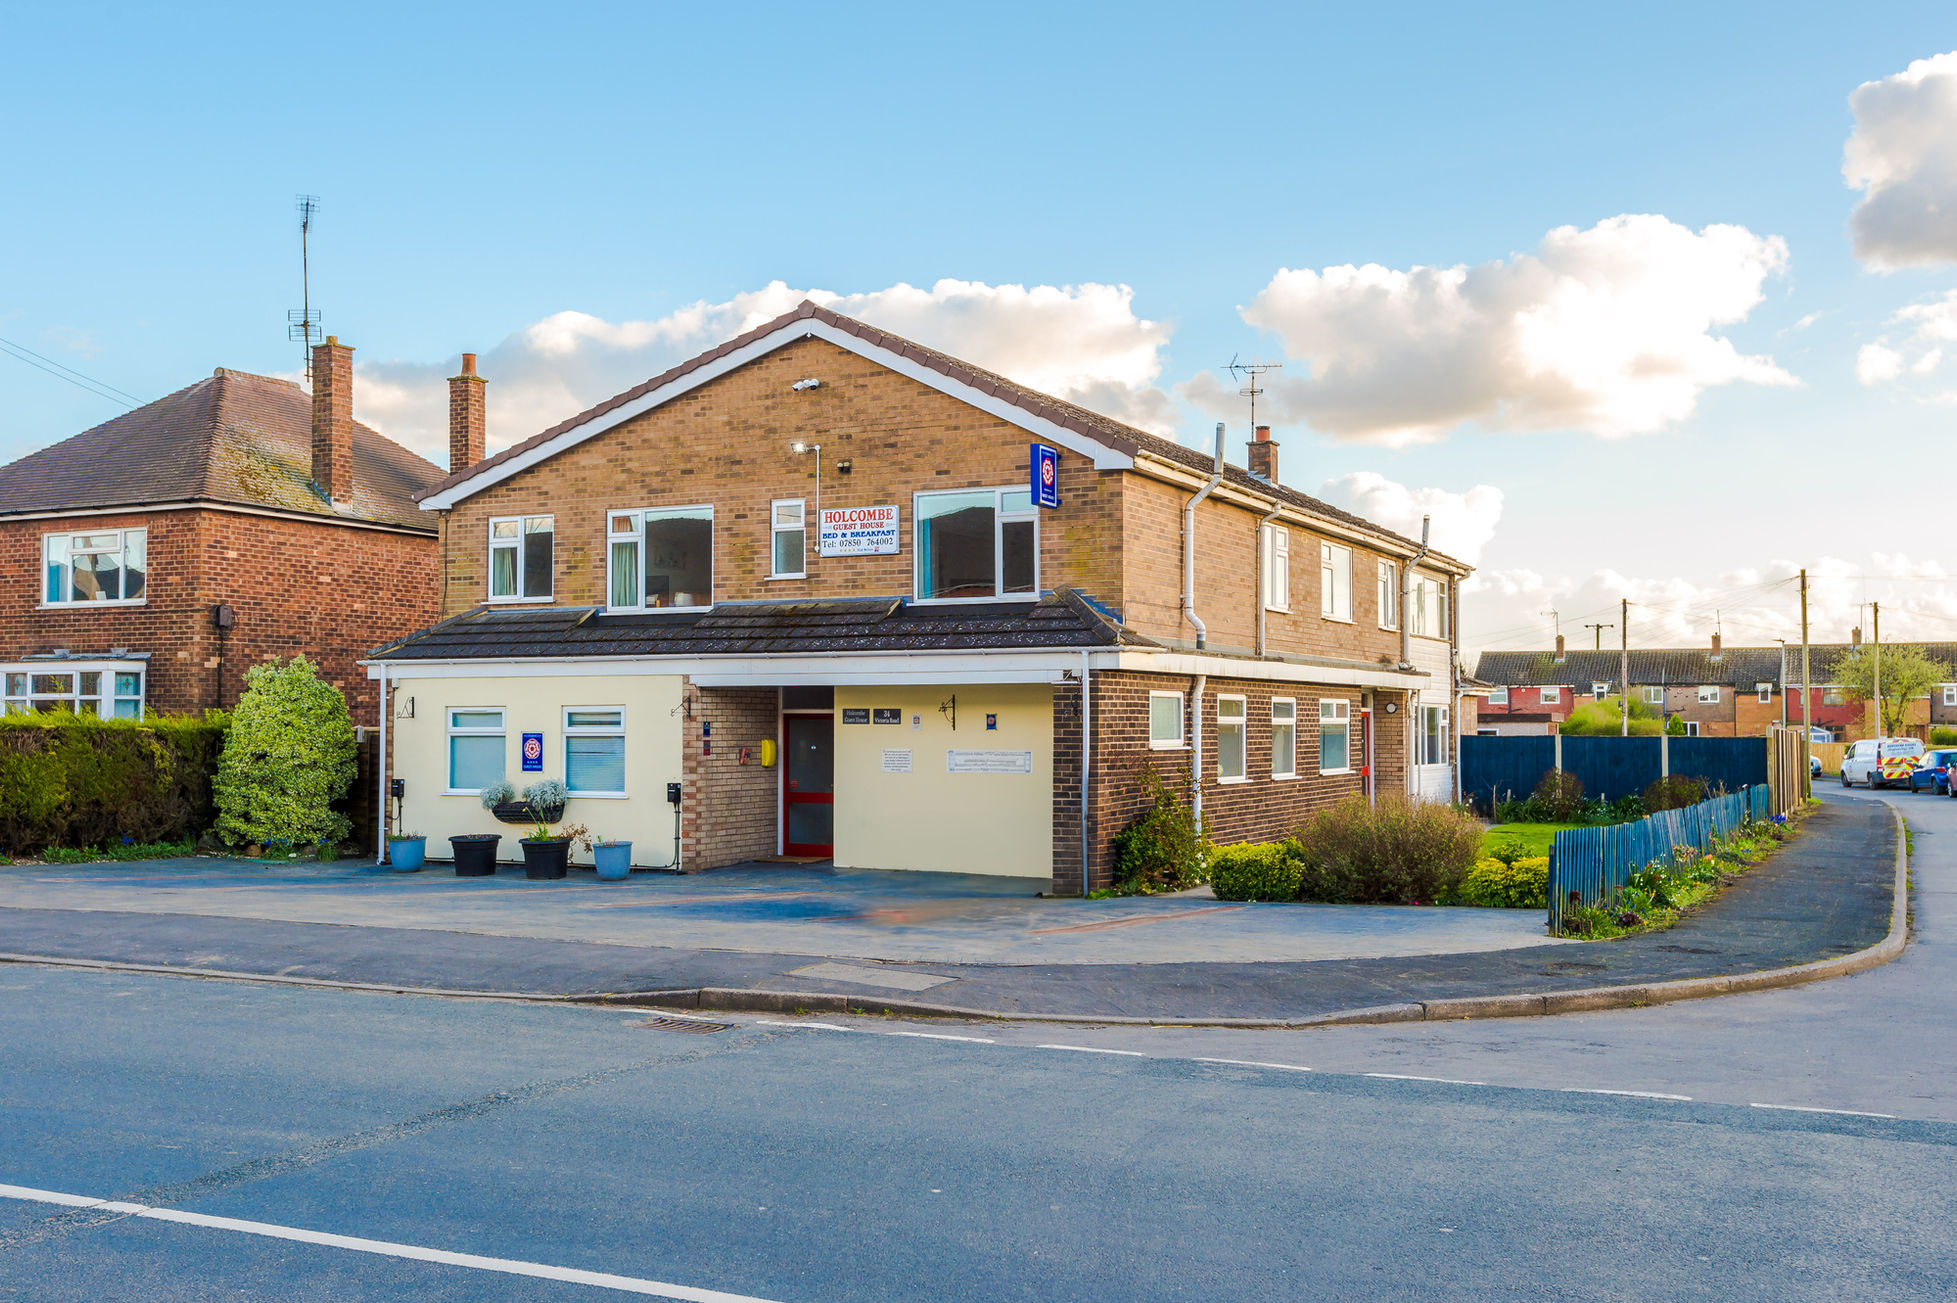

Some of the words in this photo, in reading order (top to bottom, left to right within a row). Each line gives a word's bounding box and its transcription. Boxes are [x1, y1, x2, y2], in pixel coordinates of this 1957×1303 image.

[824, 508, 894, 523] HOLCOMBE
[850, 529, 895, 537] BREAKFAST
[839, 539, 861, 547] 07850
